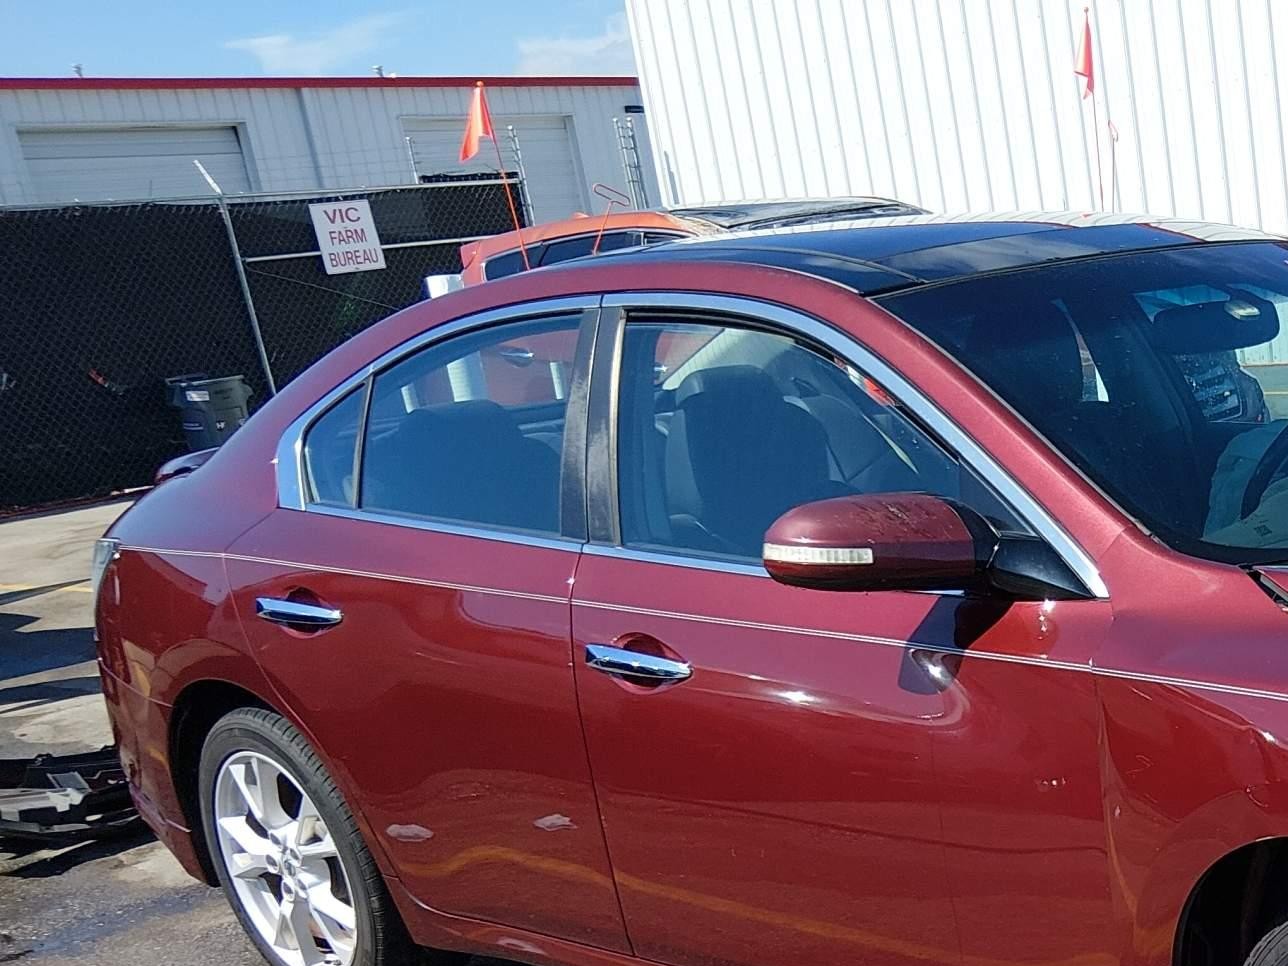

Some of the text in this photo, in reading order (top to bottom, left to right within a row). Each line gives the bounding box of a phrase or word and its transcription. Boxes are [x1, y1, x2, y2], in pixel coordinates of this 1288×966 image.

[323, 207, 361, 224] VIC
[328, 228, 368, 246] FARM
[328, 248, 379, 268] BUREAU
